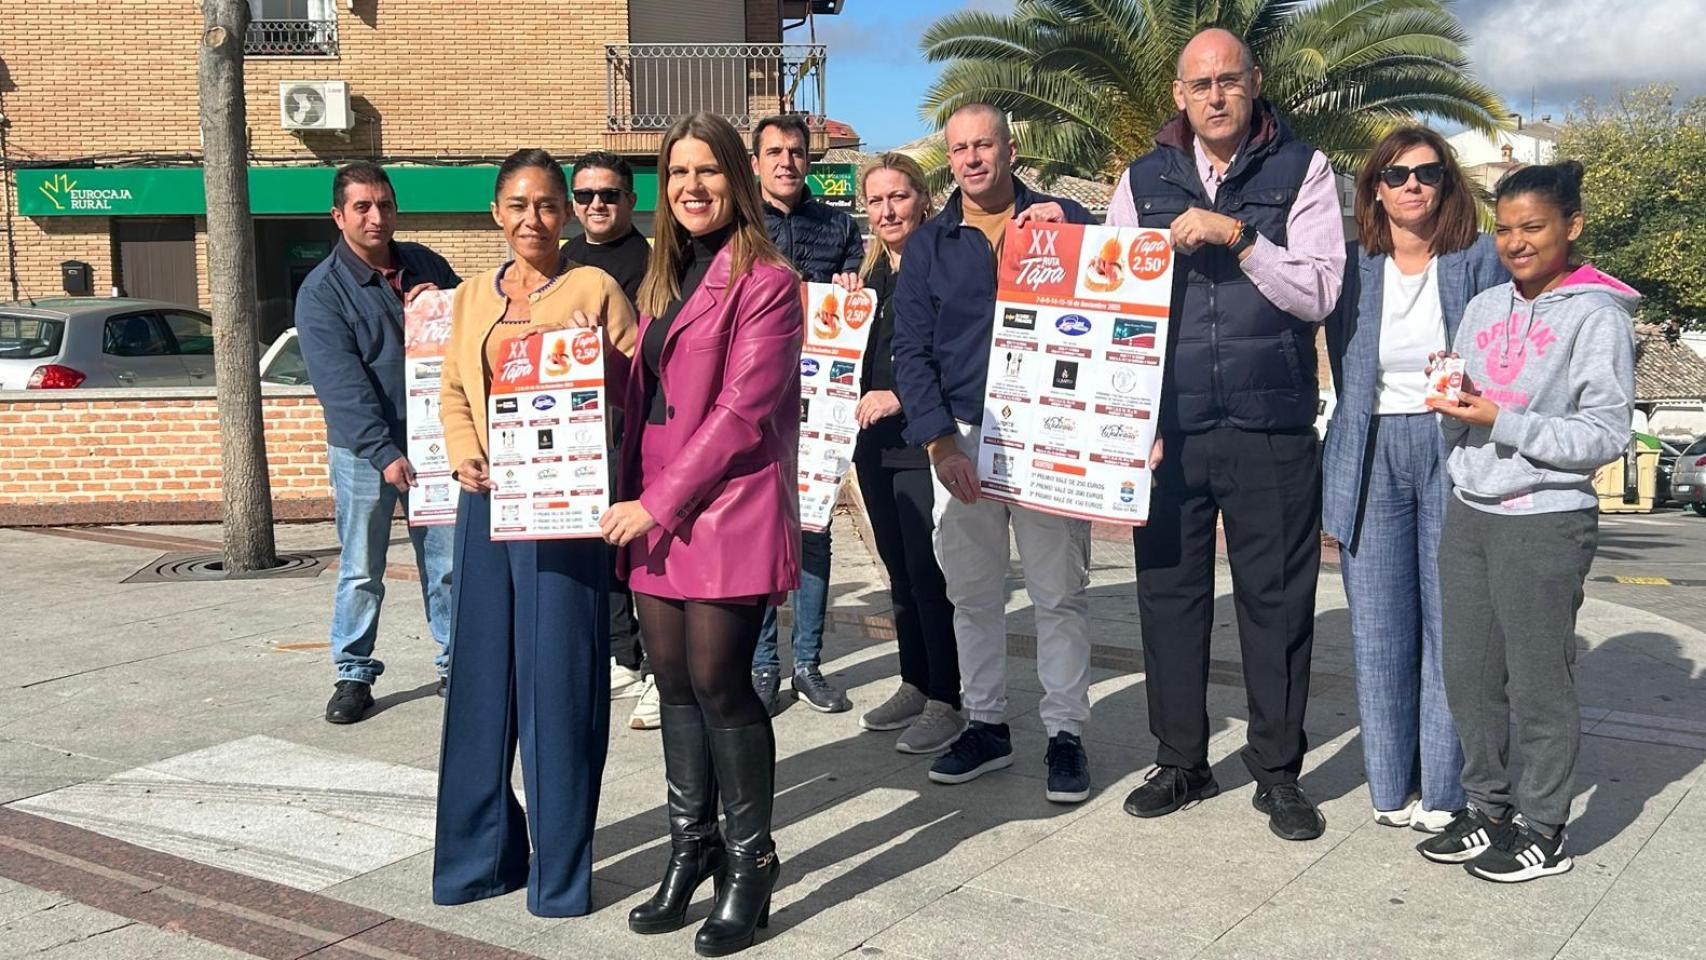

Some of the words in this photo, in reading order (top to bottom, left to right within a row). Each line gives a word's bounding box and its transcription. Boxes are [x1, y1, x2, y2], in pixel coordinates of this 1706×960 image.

[70, 189, 132, 200] EUROCAJA
[824, 179, 852, 196] 24h
[71, 200, 111, 209] RURAL
[1028, 229, 1059, 256] XX
[1133, 235, 1166, 255] Tapa
[508, 340, 529, 360] XX
[500, 359, 534, 384] Tapa
